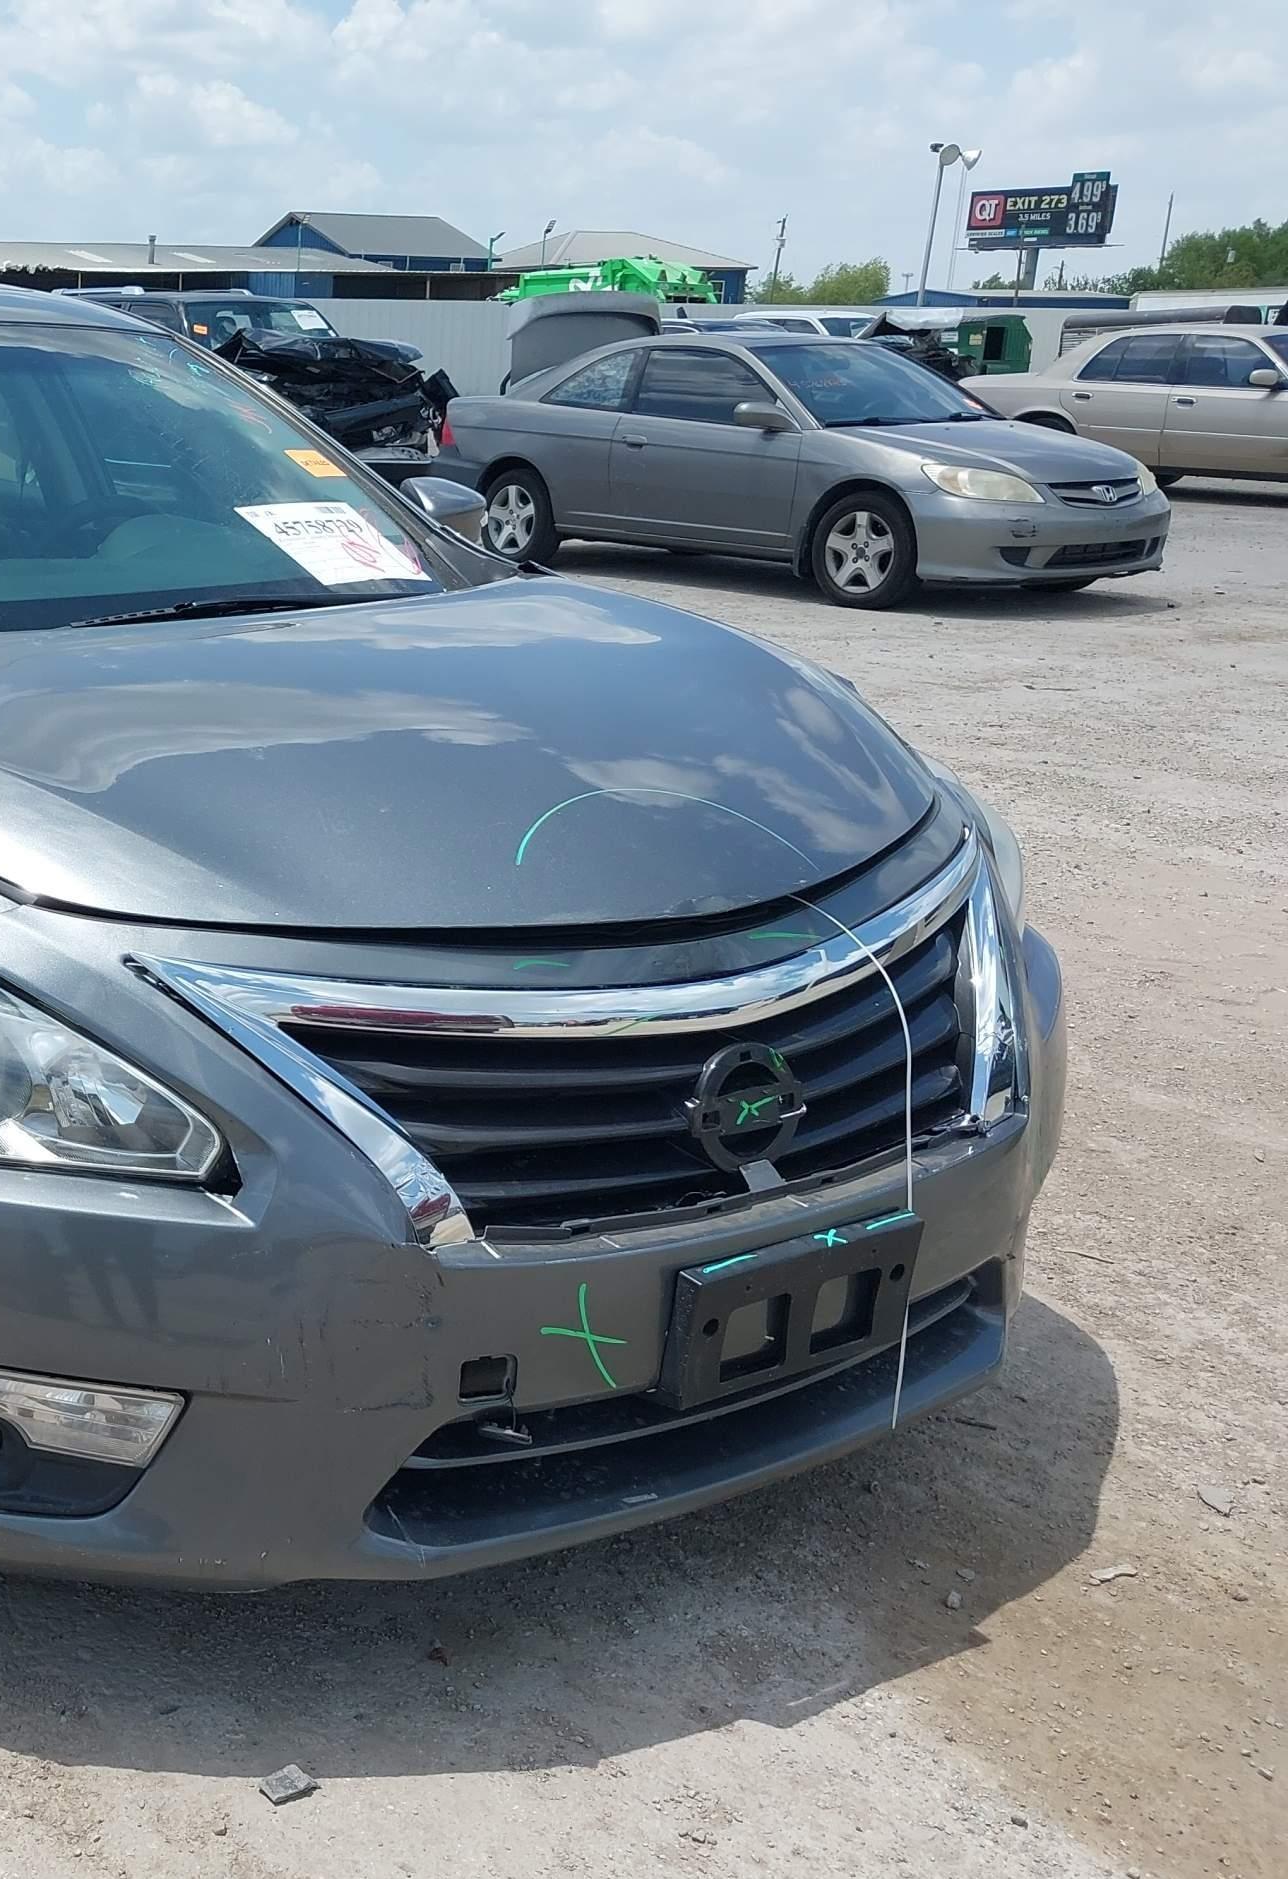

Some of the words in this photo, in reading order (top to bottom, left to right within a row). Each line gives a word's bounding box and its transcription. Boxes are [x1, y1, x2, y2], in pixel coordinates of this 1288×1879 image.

[975, 199, 999, 221] QT
[1006, 196, 1038, 210] EXIT
[1040, 194, 1068, 209] 273
[1030, 212, 1051, 220] MILES
[273, 519, 363, 537] 45758729
